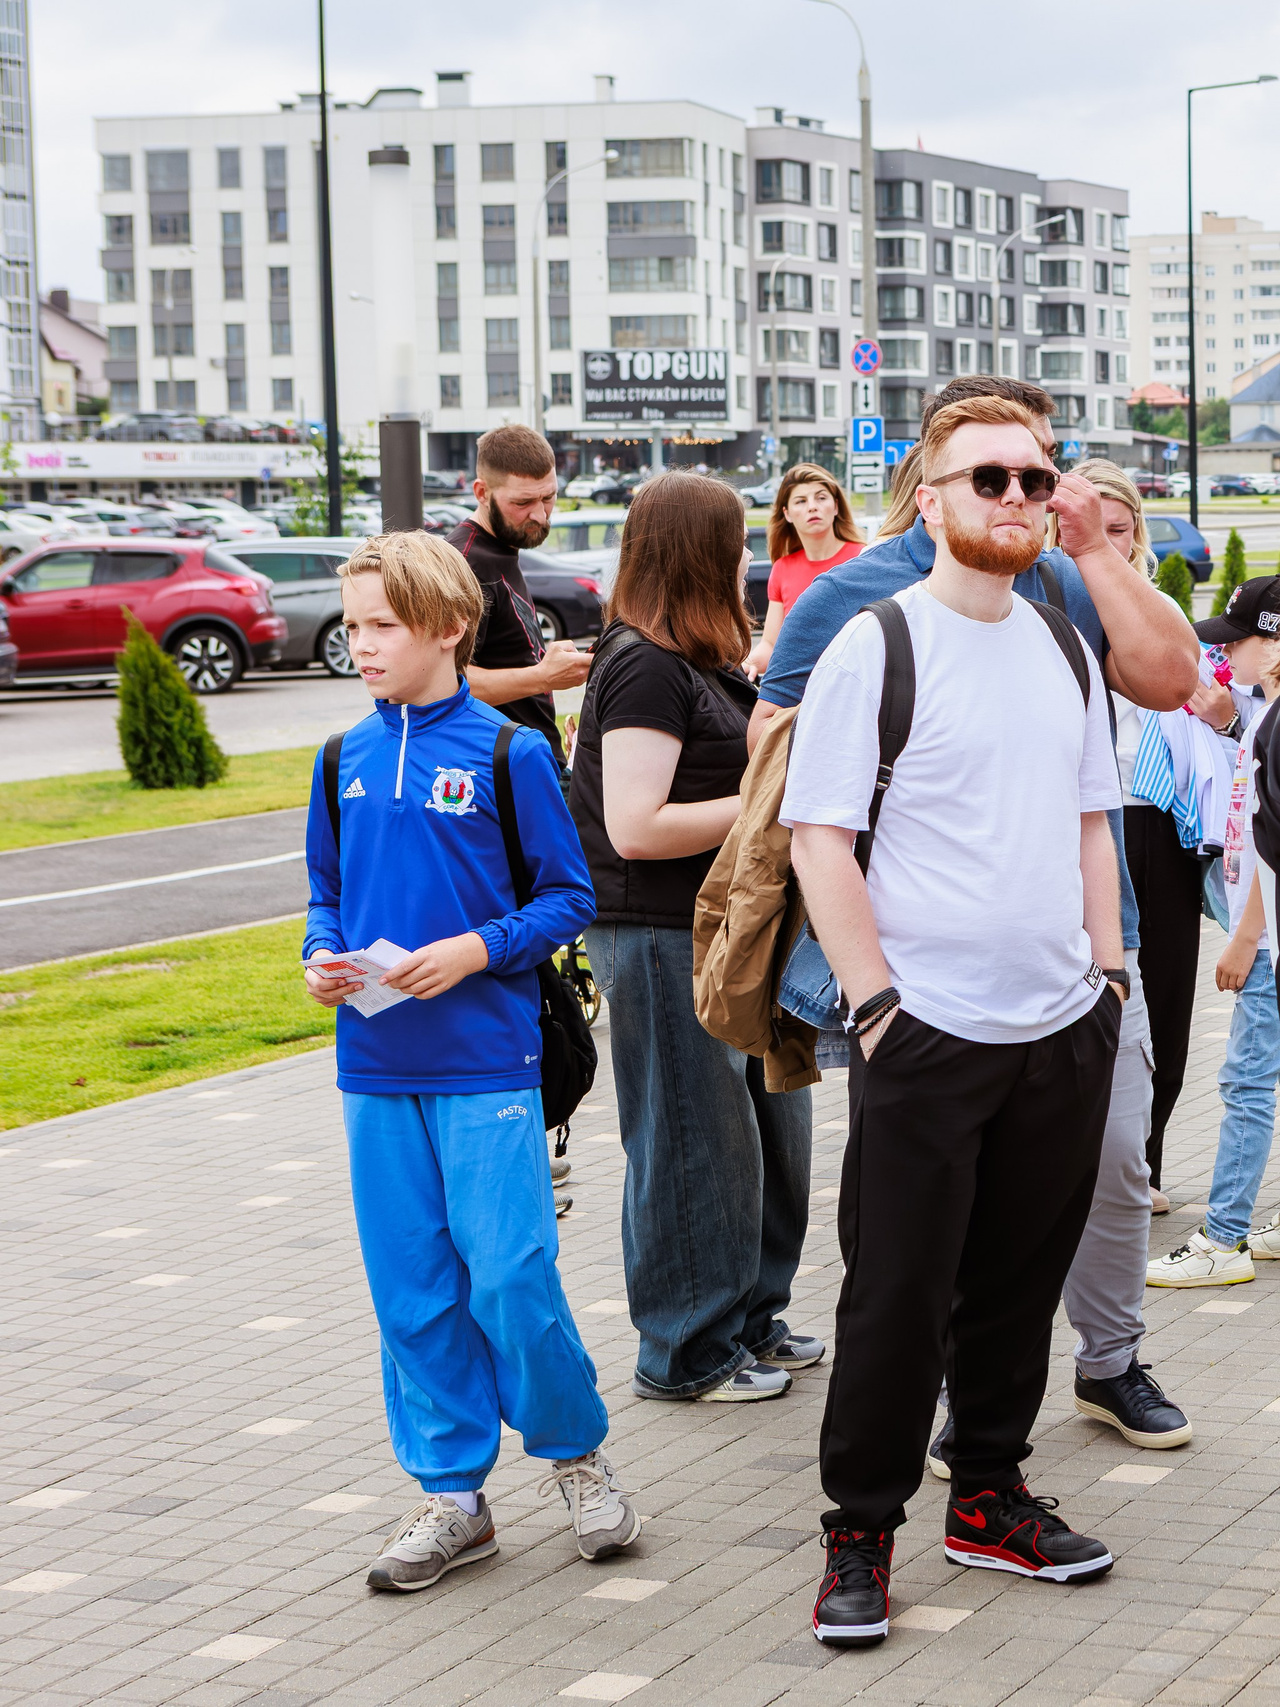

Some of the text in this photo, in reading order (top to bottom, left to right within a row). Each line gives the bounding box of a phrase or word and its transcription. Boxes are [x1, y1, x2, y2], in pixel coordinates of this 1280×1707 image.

[615, 351, 726, 380] TOPGUN
[585, 388, 603, 402] МЫ
[604, 388, 627, 402] ВАС
[681, 387, 689, 401] И
[690, 387, 726, 401] БРЕЕМ
[858, 420, 877, 450] P
[343, 789, 366, 799] adidas
[496, 1105, 528, 1120] FASTER
